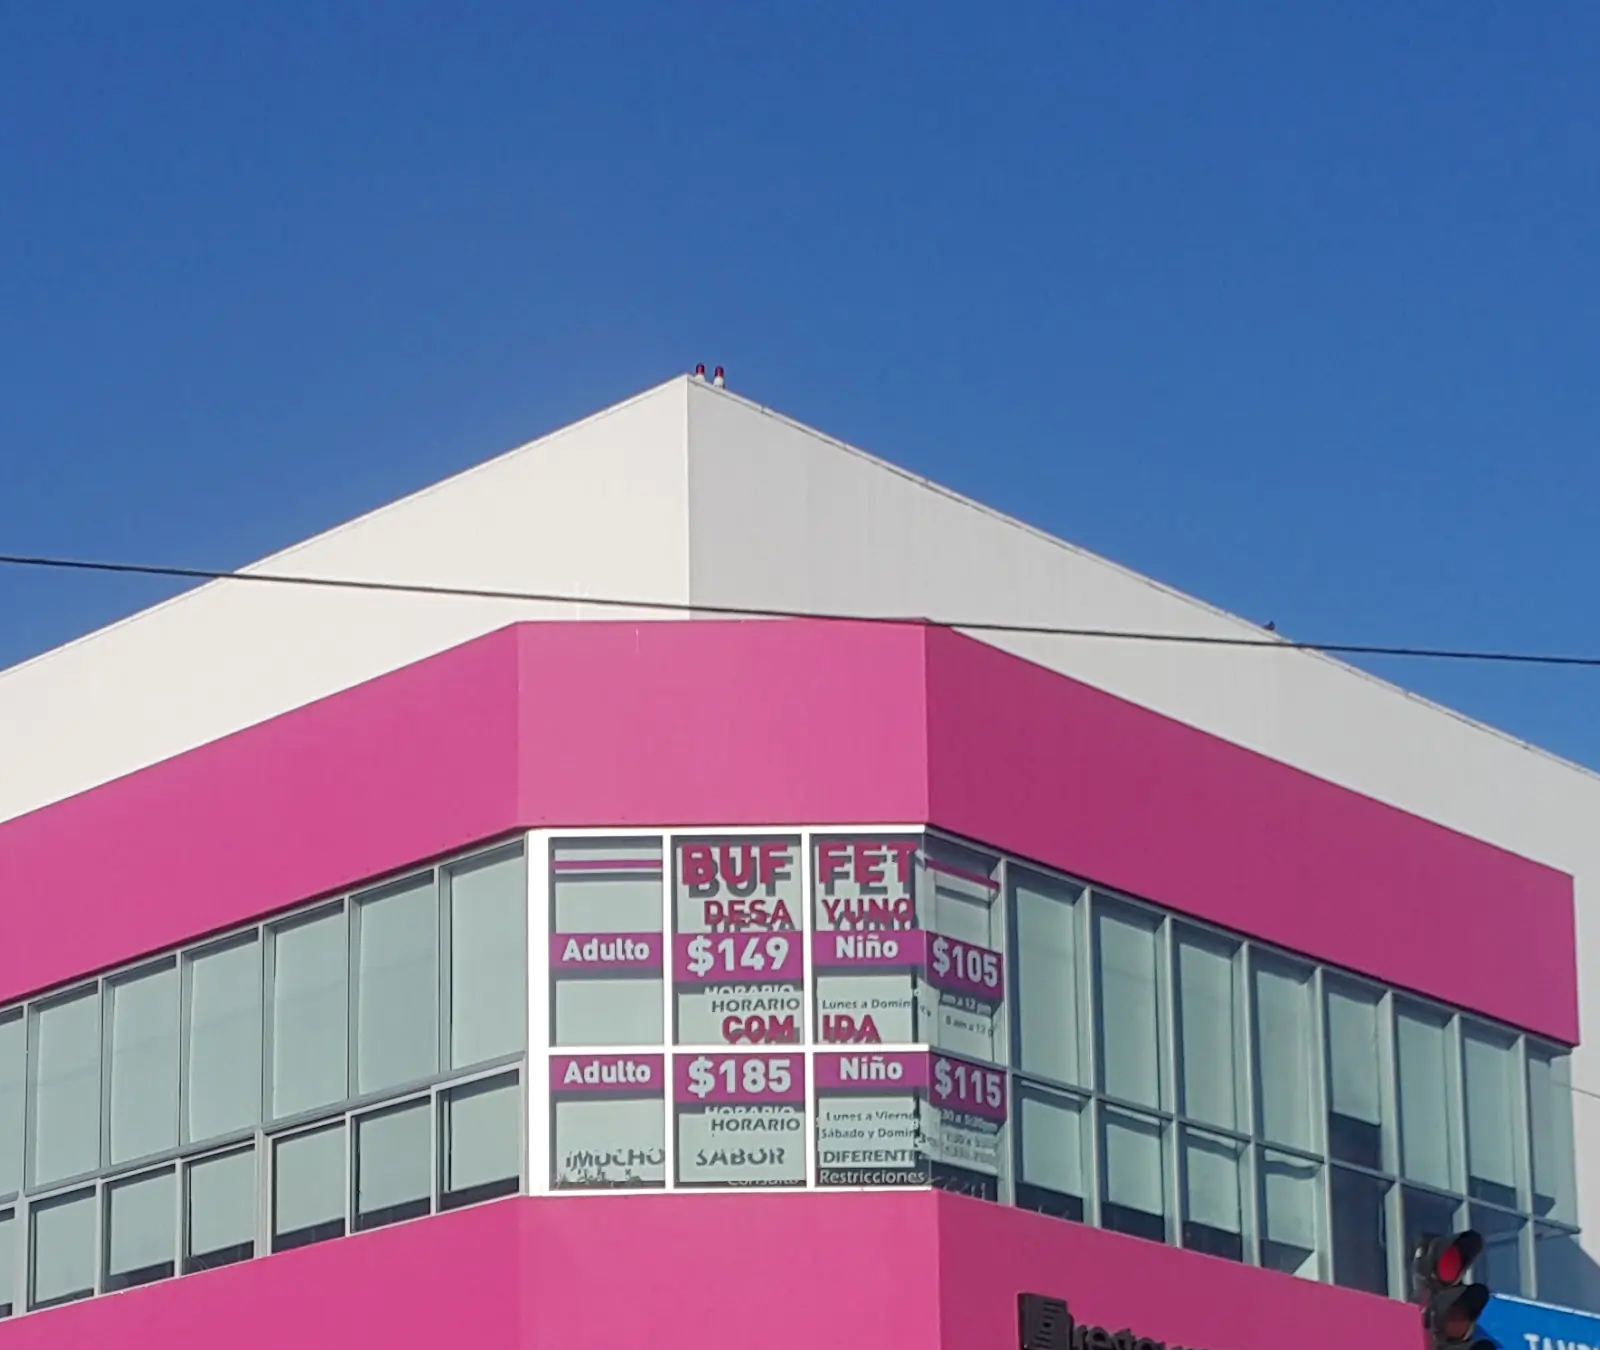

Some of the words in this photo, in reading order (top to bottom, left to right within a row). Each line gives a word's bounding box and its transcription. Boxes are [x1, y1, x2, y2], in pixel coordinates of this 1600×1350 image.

[681, 842, 789, 887] BUF
[818, 841, 918, 885] FET
[704, 899, 794, 926] DESA
[821, 898, 915, 926] YUNO
[561, 937, 651, 962] Adulto
[686, 934, 790, 978] $149
[835, 932, 899, 960] Niño
[931, 936, 999, 988] $105
[710, 997, 801, 1014] HORARIO
[822, 999, 857, 1010] Lunes
[861, 1001, 868, 1010] a
[721, 1014, 795, 1045] COM
[822, 1013, 882, 1044] IDA
[563, 1059, 651, 1085] Adulto
[687, 1056, 791, 1099] $185
[839, 1053, 903, 1081] Niño
[933, 1057, 1001, 1109] $115
[710, 1117, 801, 1132] HORARIO
[695, 1147, 786, 1166] SABOR
[819, 1169, 926, 1184] Restricciones
